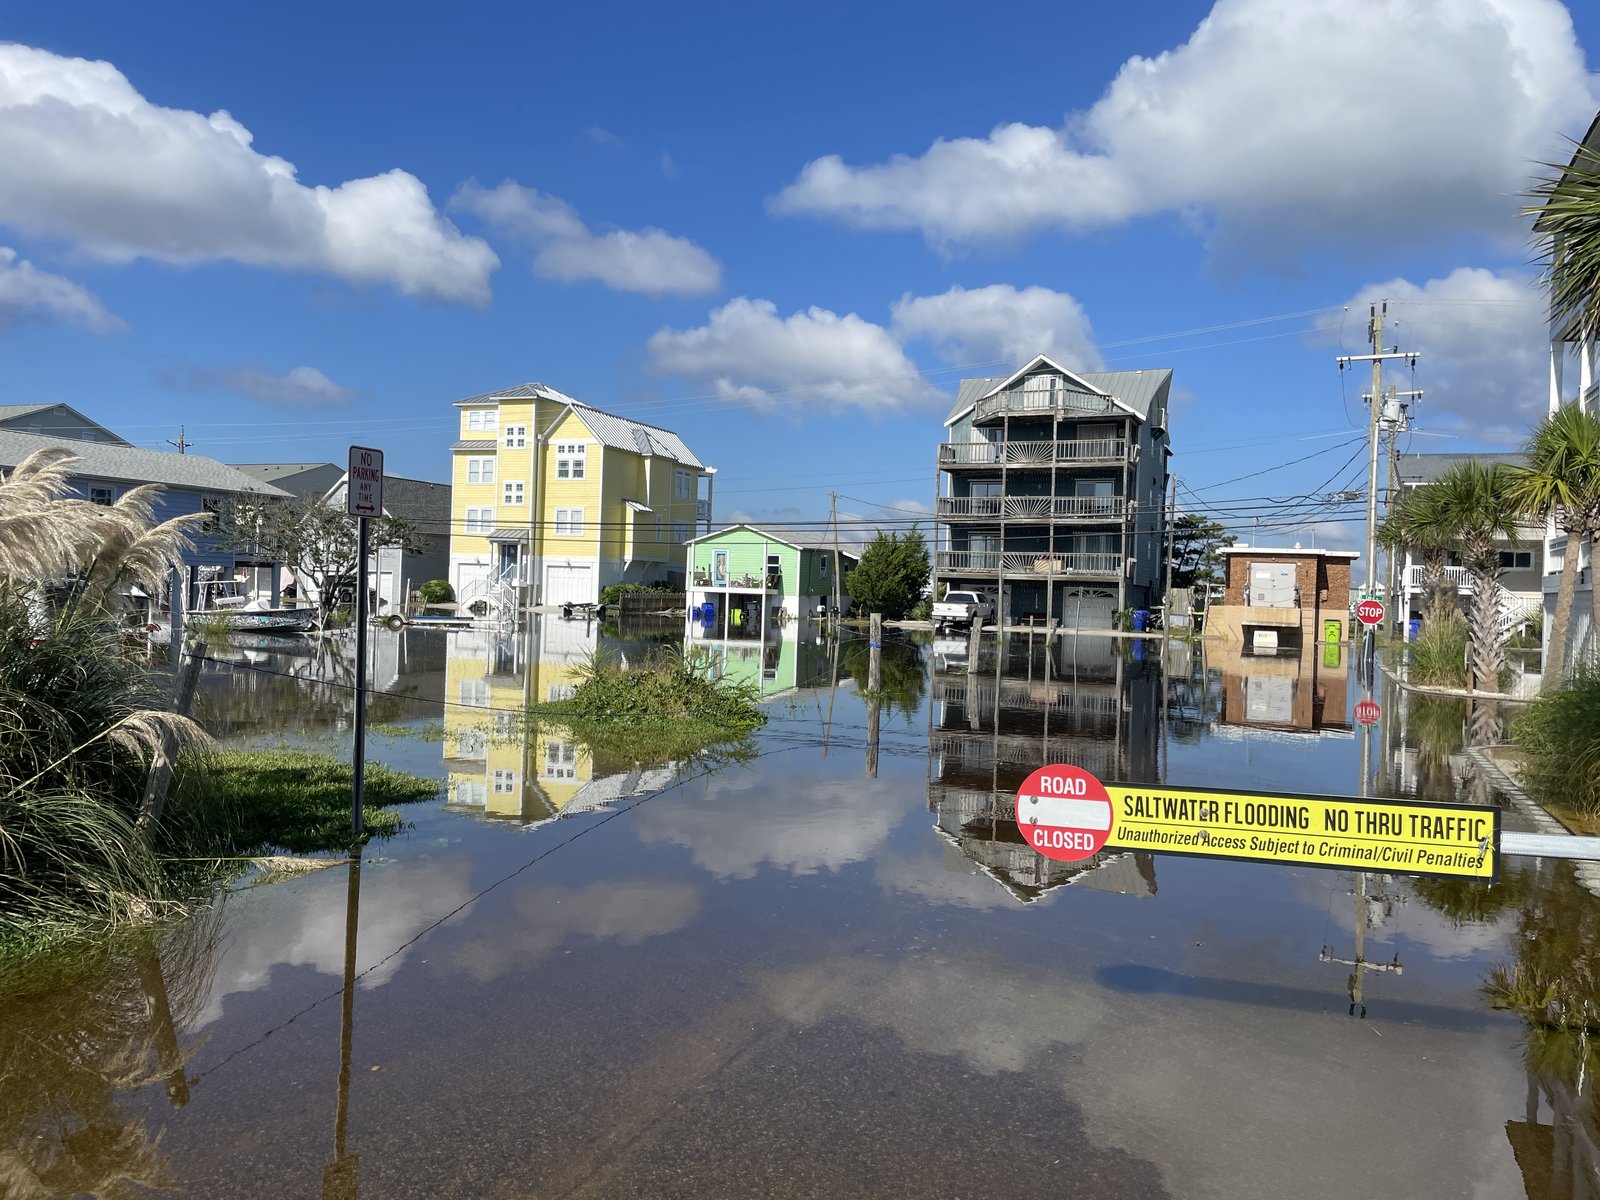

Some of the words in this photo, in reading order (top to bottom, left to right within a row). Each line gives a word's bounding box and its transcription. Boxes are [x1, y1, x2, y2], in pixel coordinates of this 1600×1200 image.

[361, 452, 372, 466] NO
[353, 467, 379, 482] PARKING
[360, 483, 371, 492] ANY
[359, 493, 372, 503] TIME
[1358, 606, 1382, 618] STOP
[1040, 776, 1087, 796] ROAD
[1124, 795, 1219, 823] SALTWATER
[1224, 801, 1310, 830] FLOODING
[1324, 808, 1349, 833] NO
[1354, 811, 1402, 836] THRU
[1408, 814, 1486, 843] TRAFFIC
[1033, 829, 1094, 851] CLOSED
[1117, 826, 1200, 846] Unauthorized
[1201, 831, 1246, 850] Access
[1250, 836, 1299, 856] Subject
[1302, 841, 1315, 856] to
[1319, 842, 1412, 863] Criminal/Civil
[1416, 849, 1484, 869] Penalties
